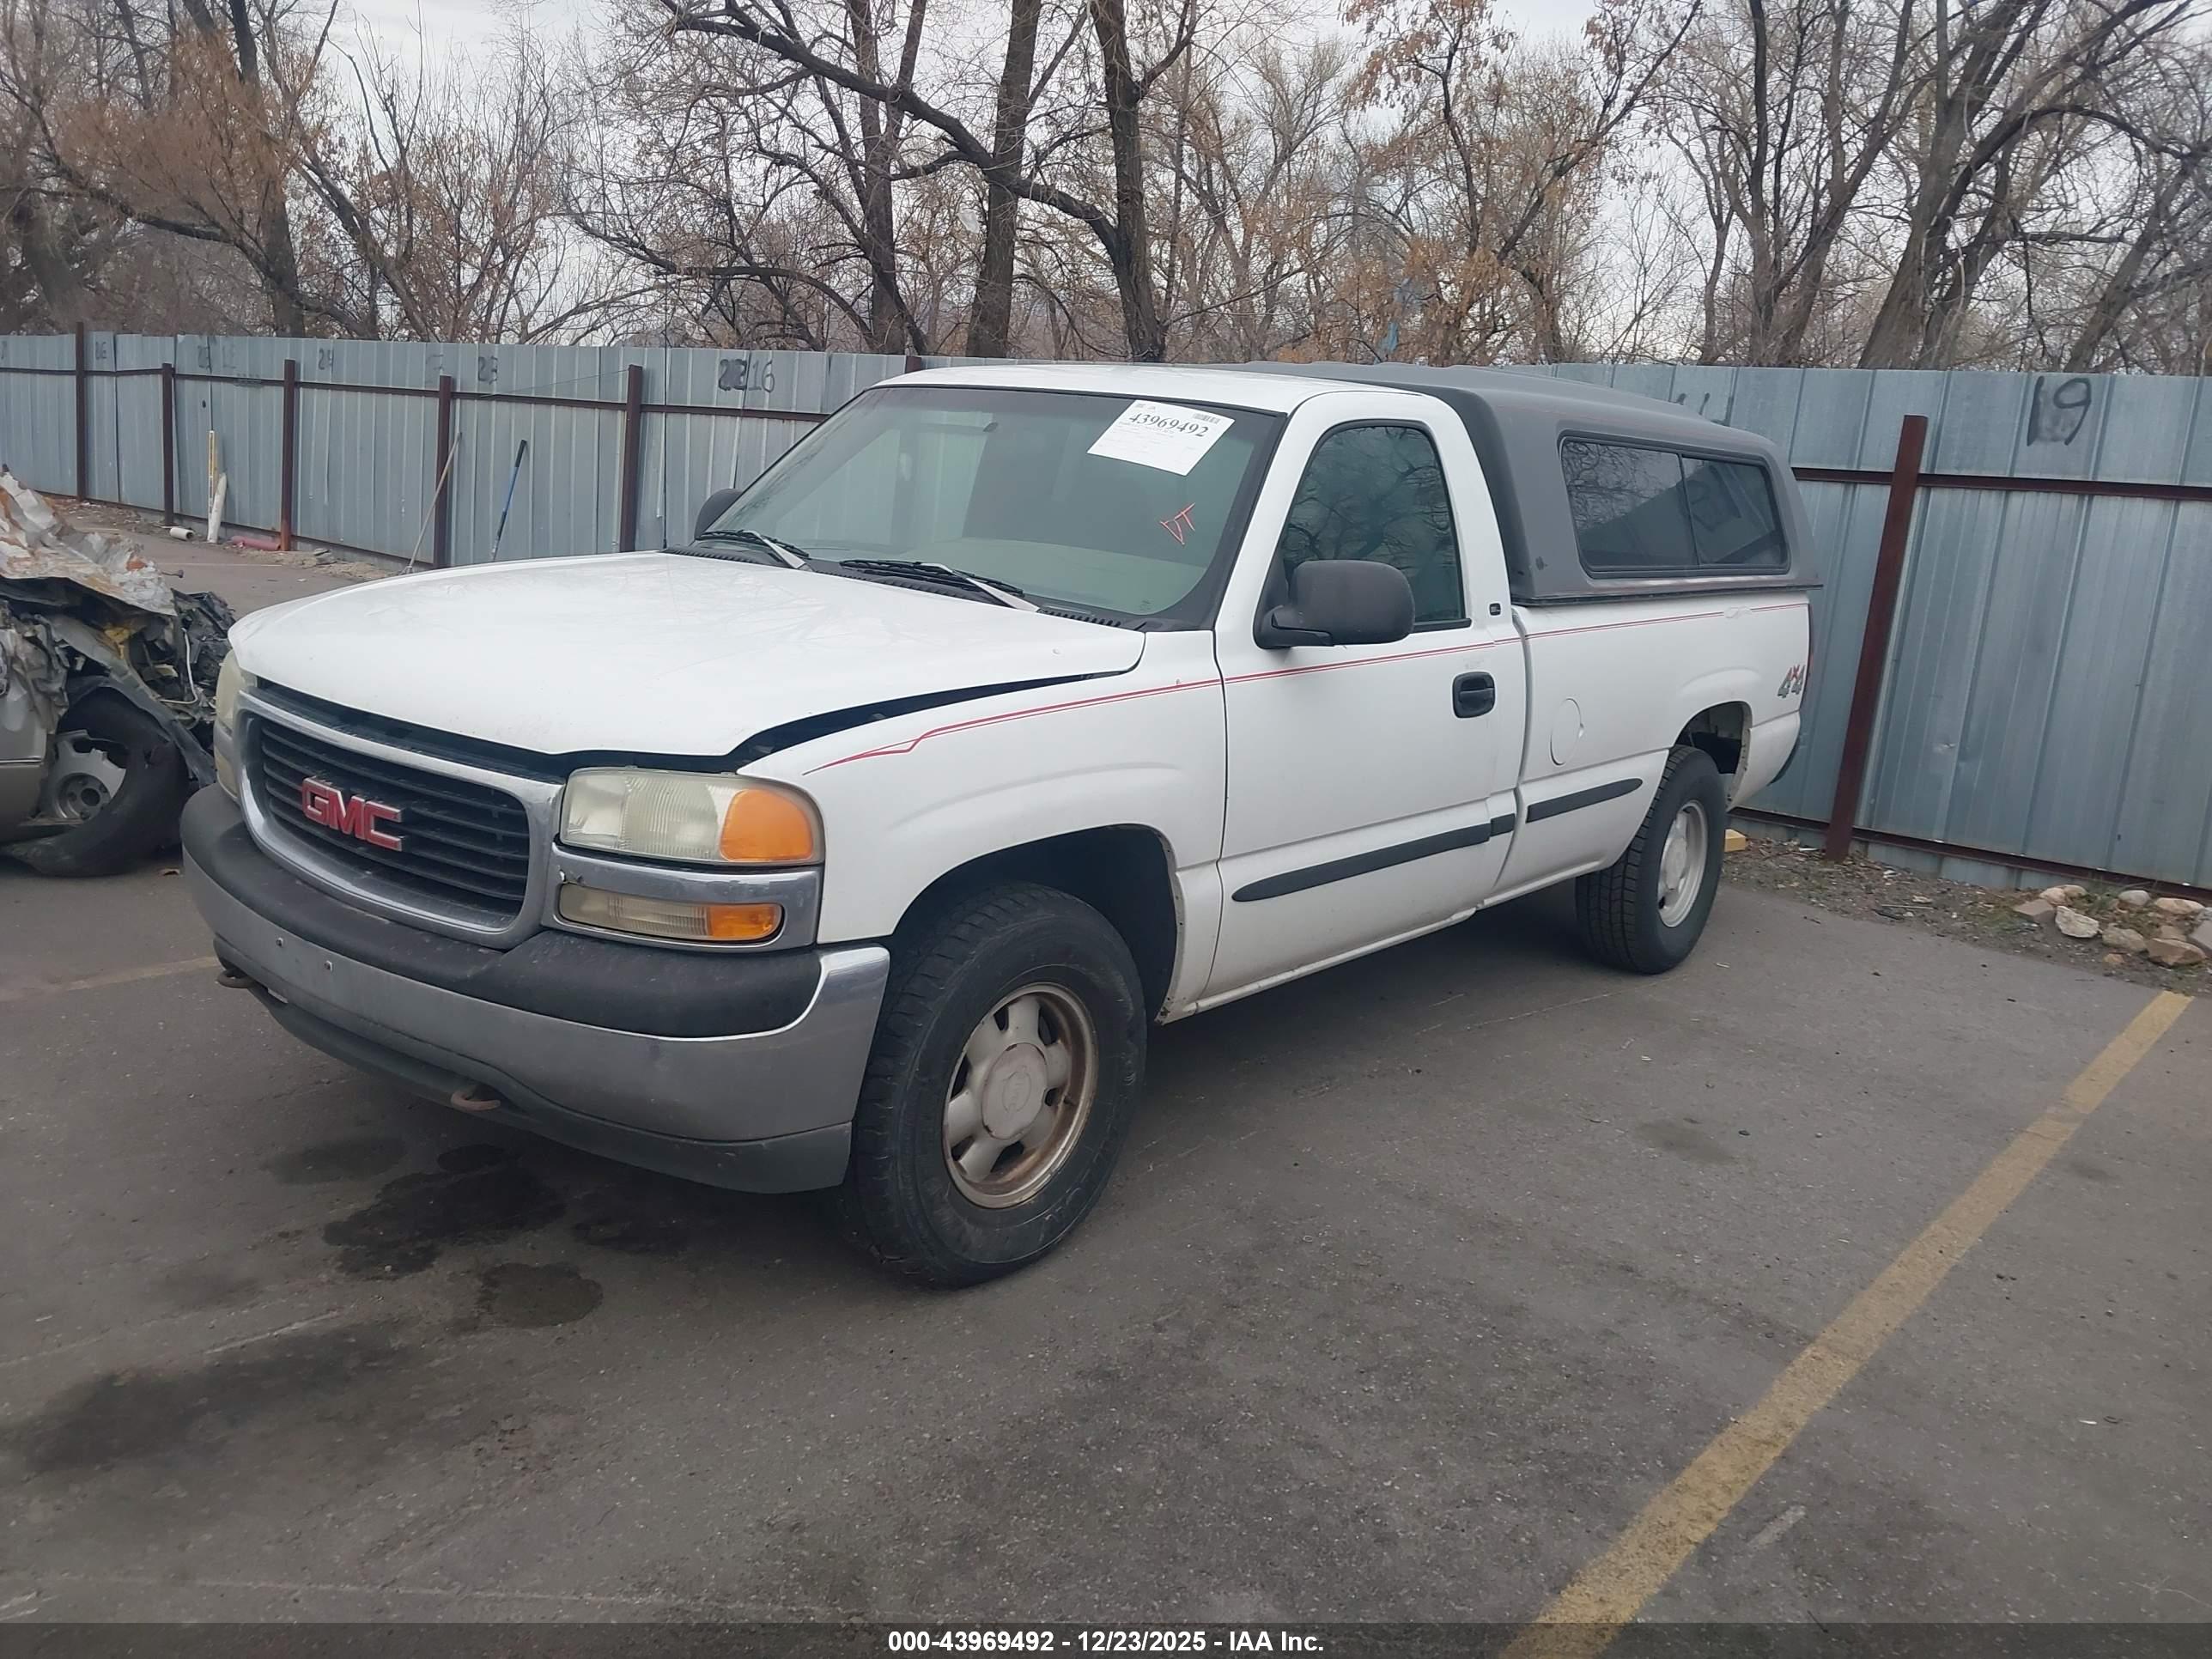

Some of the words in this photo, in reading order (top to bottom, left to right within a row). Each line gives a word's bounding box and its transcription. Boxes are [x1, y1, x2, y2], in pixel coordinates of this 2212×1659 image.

[1128, 412, 1209, 438] 43969492
[2027, 375, 2093, 447] 19
[301, 776, 404, 852] GMC
